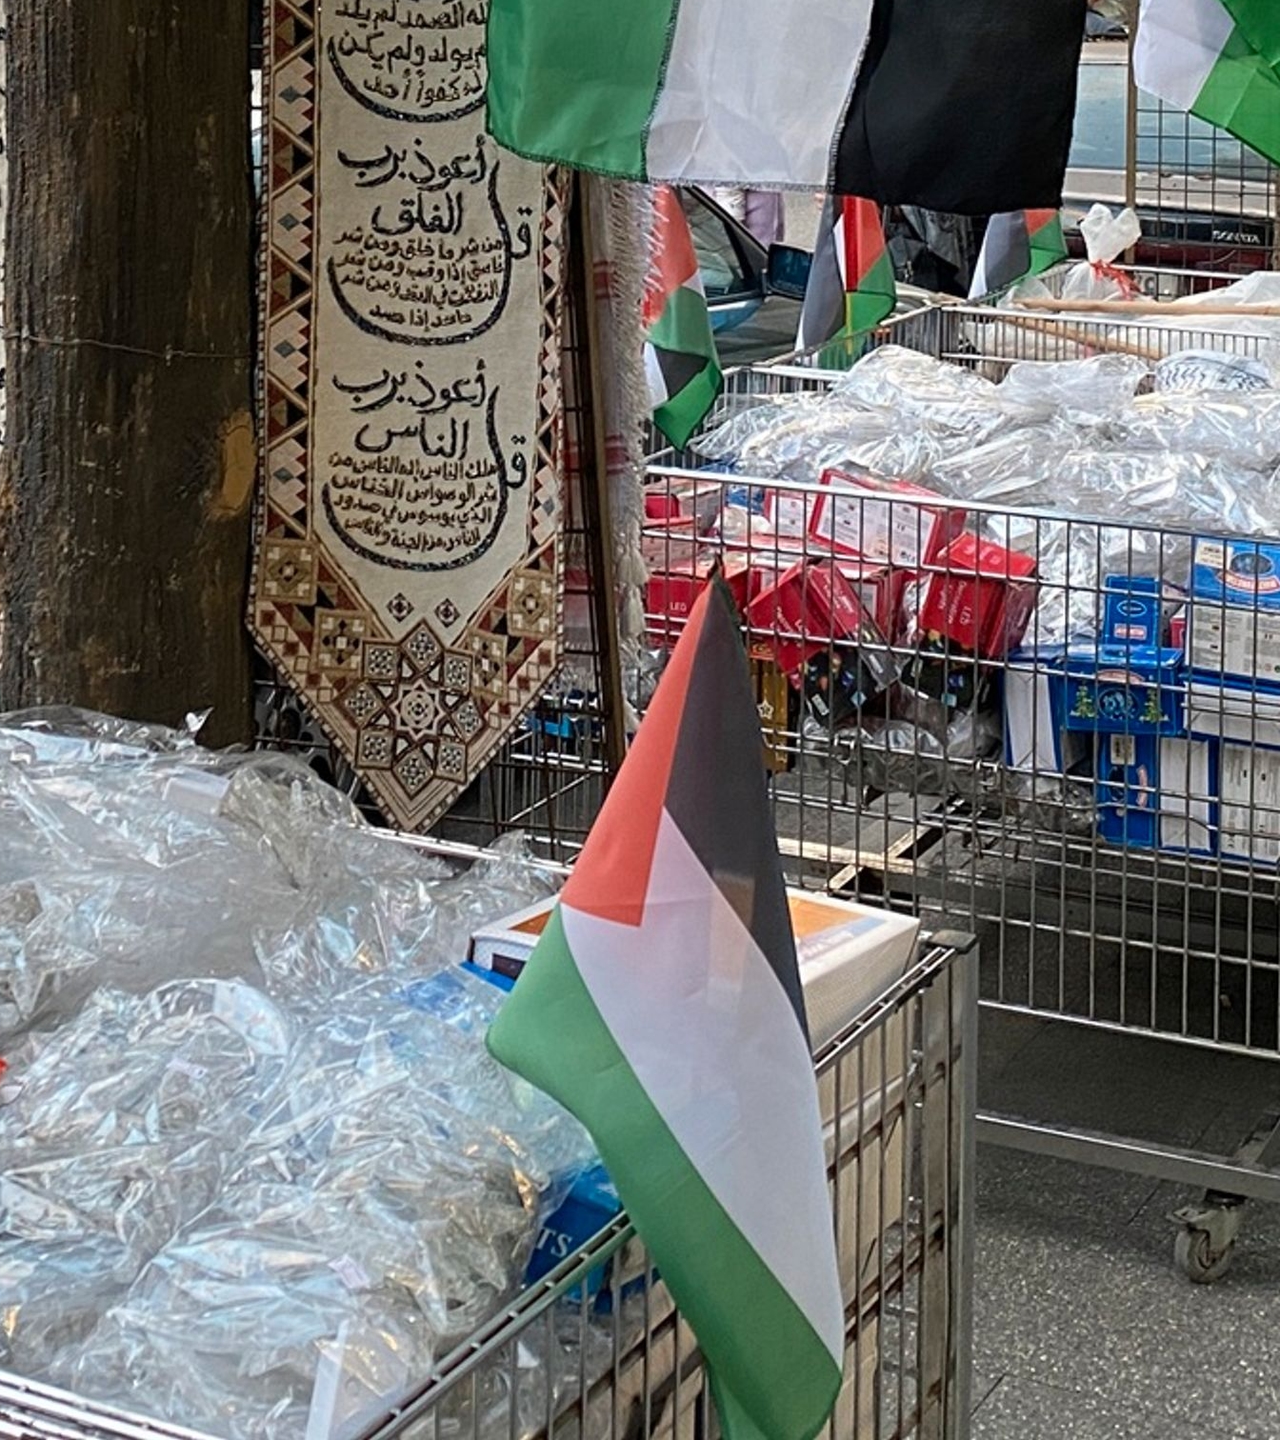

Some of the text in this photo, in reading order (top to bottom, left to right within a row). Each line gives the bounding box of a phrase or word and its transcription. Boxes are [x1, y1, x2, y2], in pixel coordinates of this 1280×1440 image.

[338, 134, 487, 192] أعوذ برب
[371, 191, 463, 236] الفلق
[332, 357, 486, 415] أعوذ برب
[354, 416, 469, 460] الناس
